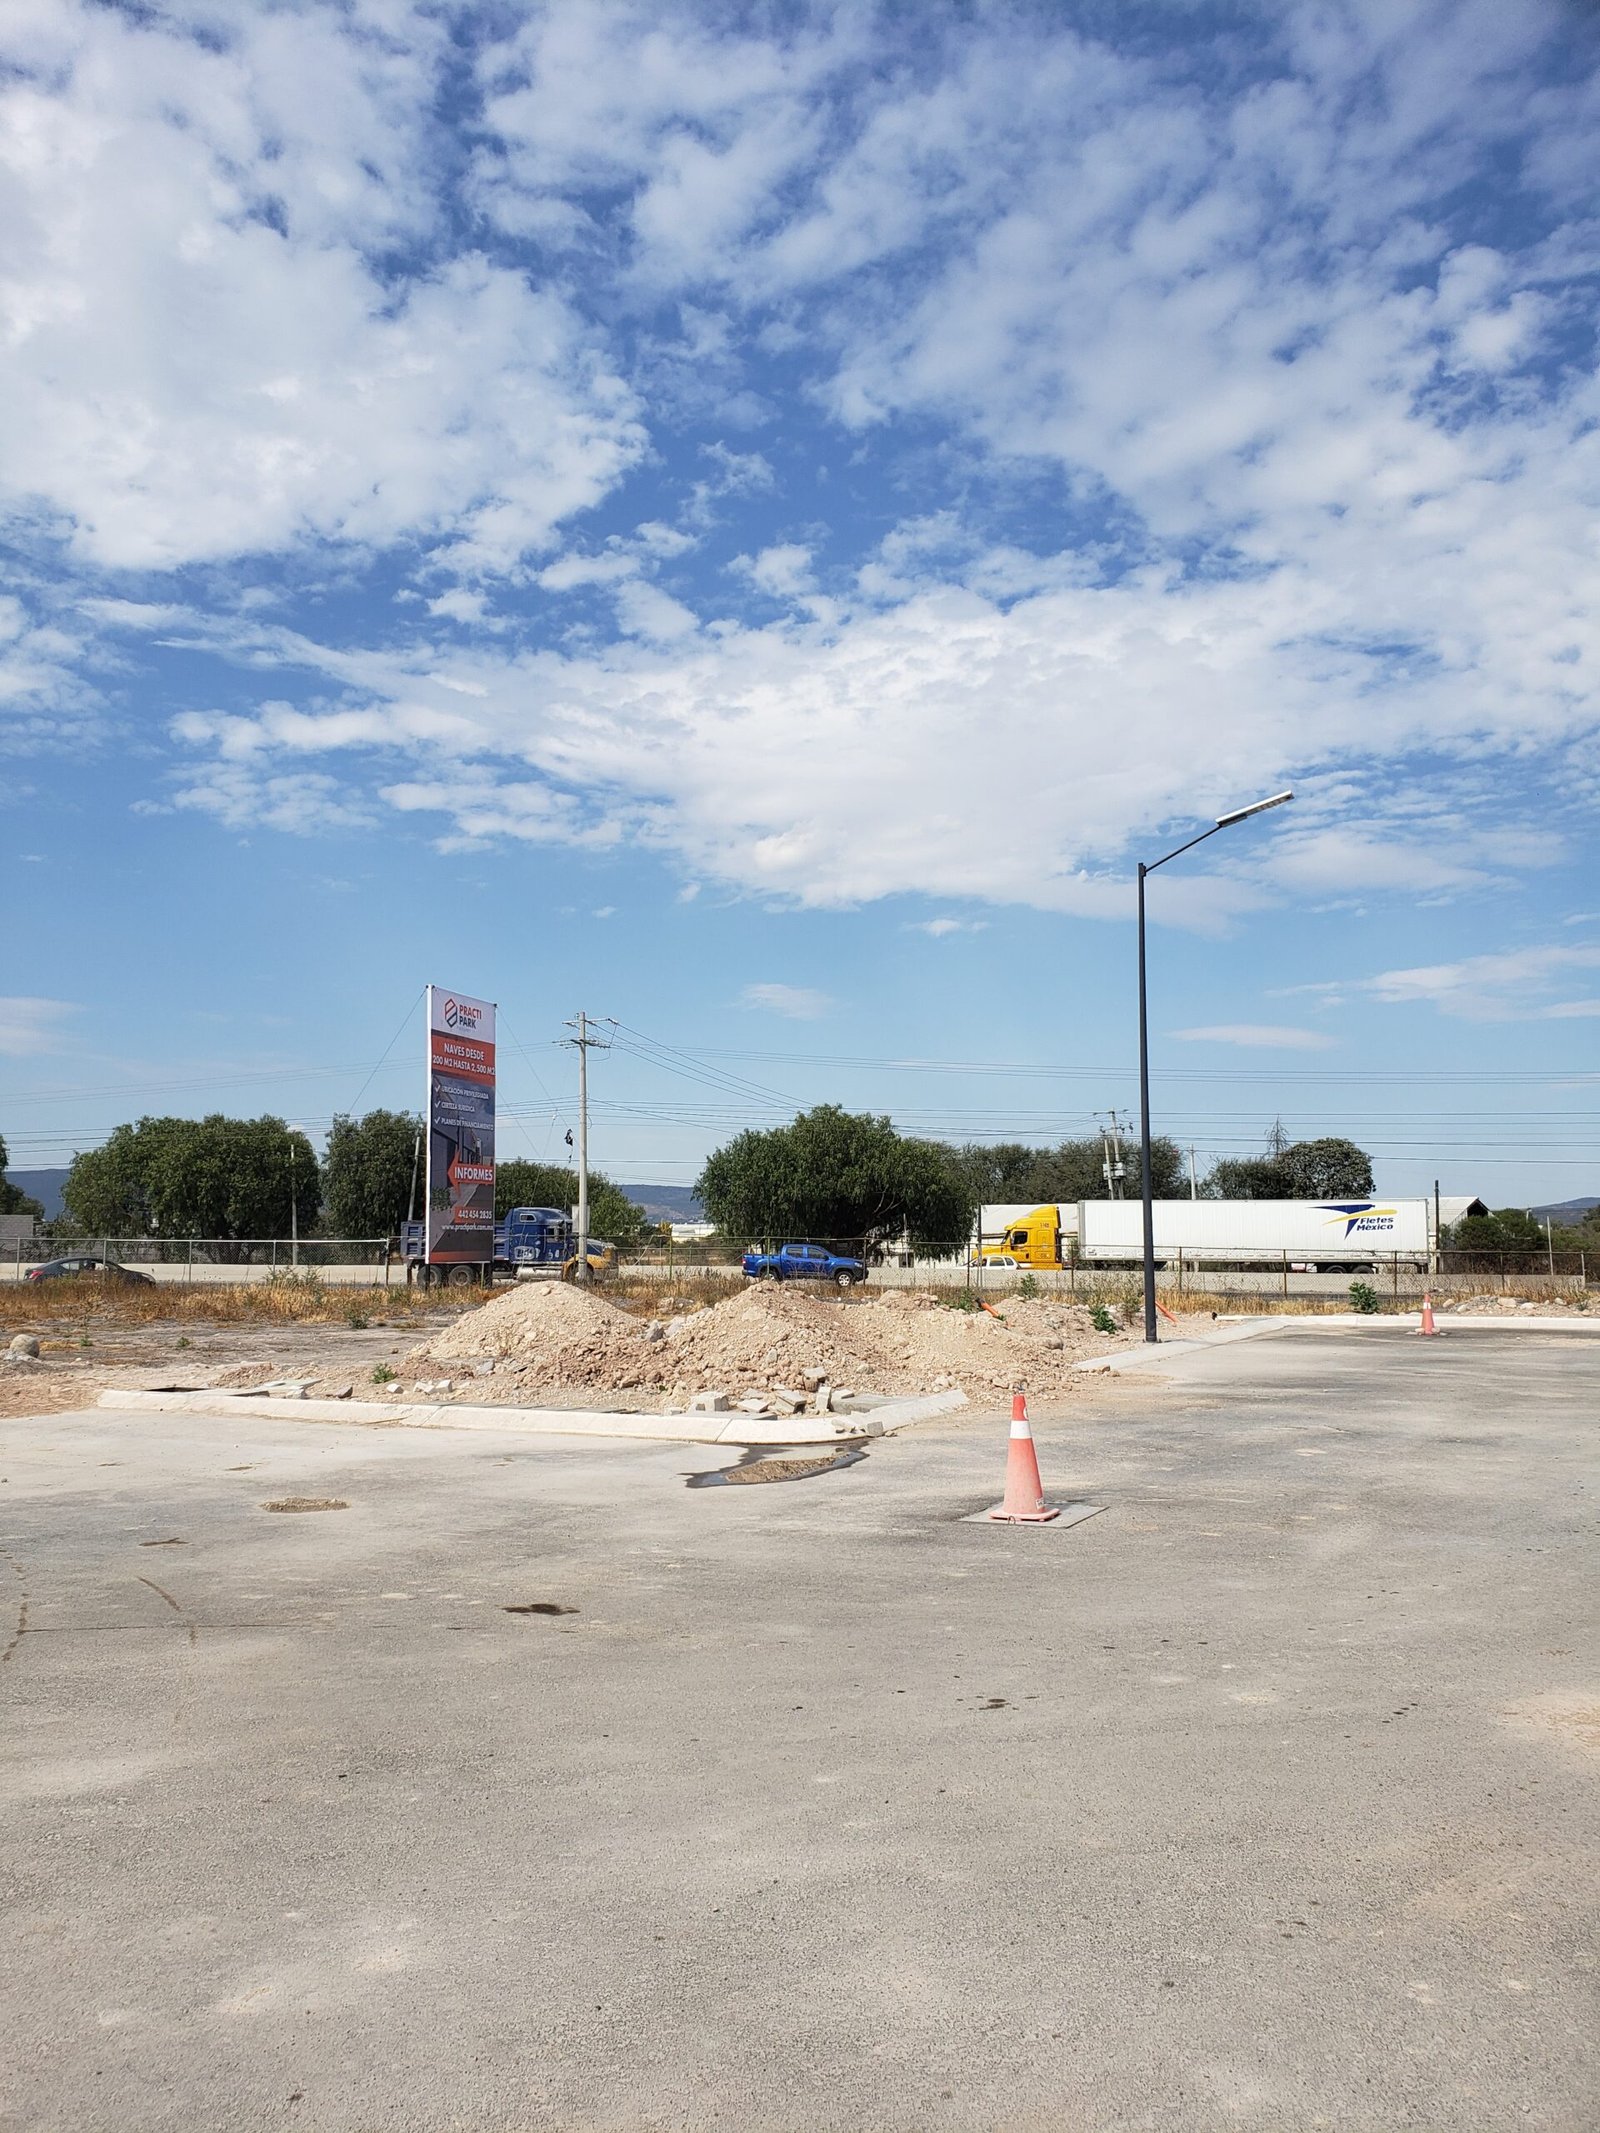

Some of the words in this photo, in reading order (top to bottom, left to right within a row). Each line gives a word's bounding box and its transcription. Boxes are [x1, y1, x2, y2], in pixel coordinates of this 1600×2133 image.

[459, 1004, 481, 1019] PRACTI
[459, 1015, 476, 1029] PARK
[444, 1043, 465, 1056] NAVES
[465, 1048, 484, 1061] DESDE
[433, 1055, 443, 1064] 200
[443, 1057, 453, 1067] M2
[453, 1059, 470, 1070] HASTA
[454, 1166, 493, 1181] INFORMES
[458, 1210, 468, 1218] 442
[469, 1210, 479, 1218] 454
